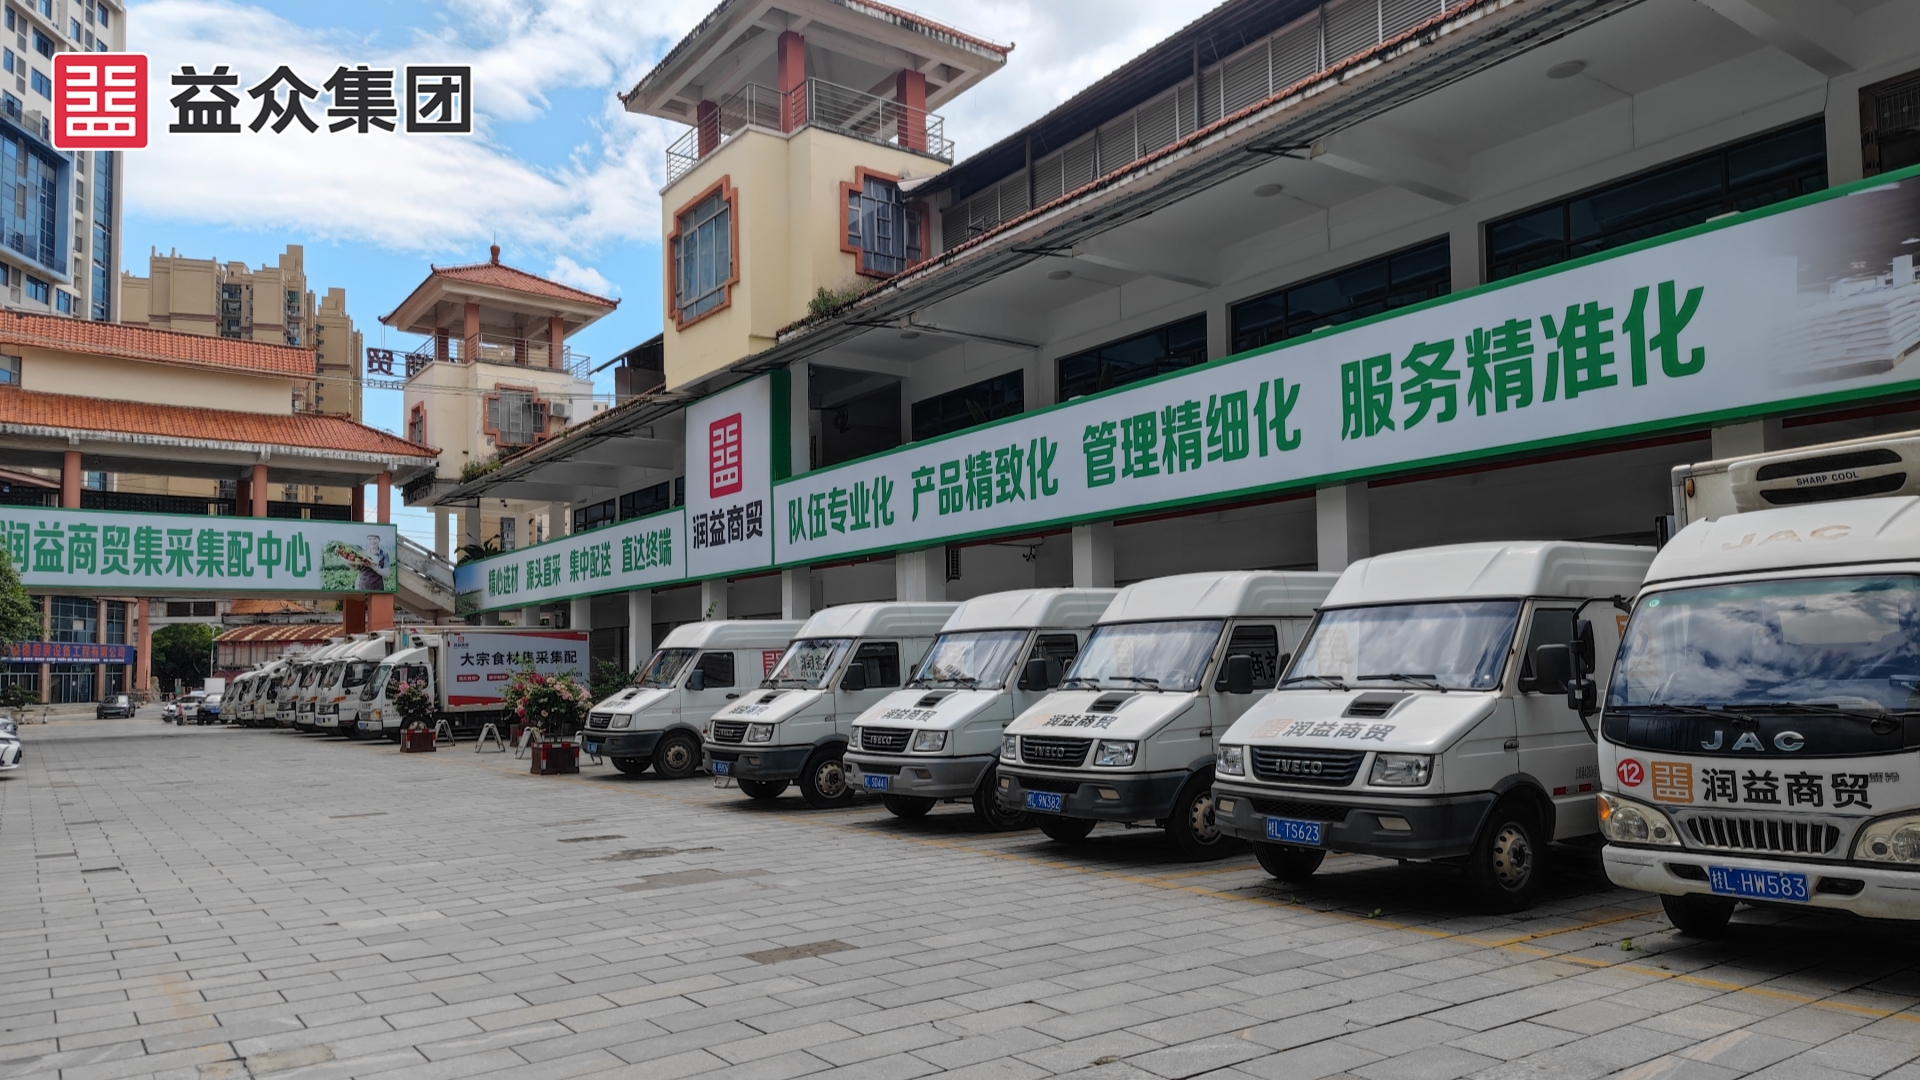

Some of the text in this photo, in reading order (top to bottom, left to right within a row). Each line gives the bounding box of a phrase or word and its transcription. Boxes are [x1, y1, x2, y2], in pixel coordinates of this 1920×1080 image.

[788, 279, 1705, 545] 队伍专业化 产品精致化 管理精细化 服务精准化
[1796, 470, 1859, 486] SHARP COOL
[692, 499, 763, 549] 润益商贸
[0, 519, 311, 579] 润益商贸集采集配中心
[1721, 525, 1852, 551] JAC
[488, 527, 672, 598] 精心选材 源头直采 集中配送 直达终端
[460, 650, 578, 667] 大宗食材集采集配
[1042, 714, 1118, 730] 润益商贸
[1282, 721, 1396, 743] 润益商贸
[1034, 745, 1065, 758] IVECO
[1701, 730, 1805, 752] JAC
[1275, 758, 1323, 775] IVECO
[1618, 763, 1641, 783] 12
[1701, 768, 1873, 810] 润益商贸
[1711, 870, 1807, 899] 桂L·HW583
